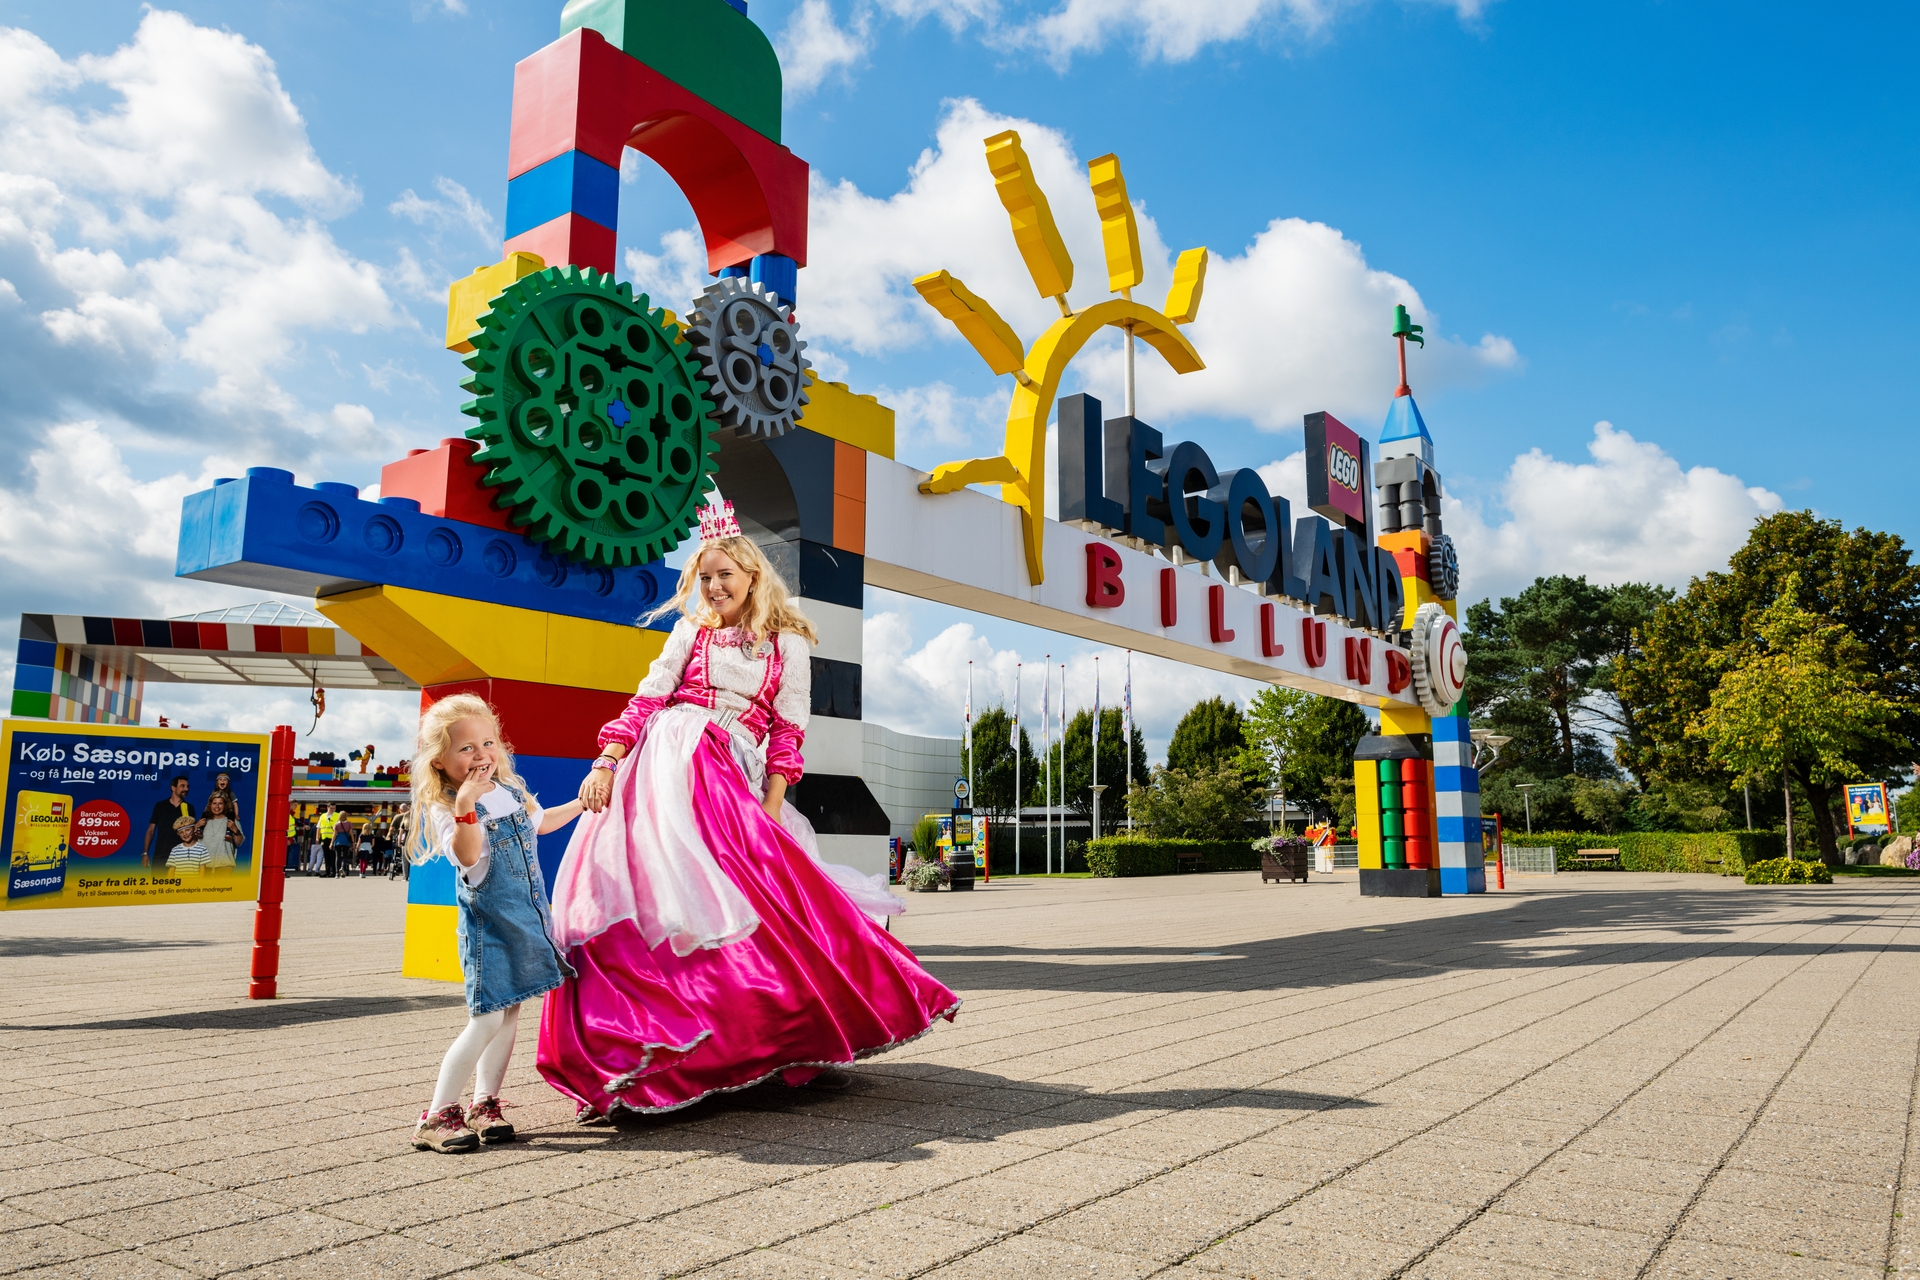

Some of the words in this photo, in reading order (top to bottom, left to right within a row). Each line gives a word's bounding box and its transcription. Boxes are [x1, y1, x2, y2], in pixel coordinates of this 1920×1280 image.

[1329, 444, 1359, 491] LEGO
[1059, 393, 1404, 631] LEGOLAND
[1085, 542, 1411, 694] BILLUND
[20, 742, 66, 762] Køb
[72, 742, 200, 770] Sæsonpas
[206, 750, 211, 767] i
[216, 751, 252, 773] dag
[30, 770, 45, 780] og
[48, 768, 60, 778] få
[63, 767, 95, 780] hele
[98, 769, 132, 780] 2019
[134, 772, 158, 781] med
[30, 814, 69, 824] LEGOLAND
[80, 810, 120, 818] Barn/Senior
[78, 817, 102, 827] 499
[76, 836, 100, 846] 579
[100, 838, 118, 846] DKK
[13, 876, 62, 890] Sæsonpas
[78, 878, 103, 889] Spar
[106, 878, 120, 887] fra
[123, 877, 137, 886] dit
[139, 877, 149, 886] 2.
[152, 876, 182, 887] besøg
[77, 890, 88, 898] Byt
[97, 889, 129, 897] Sæsonpas
